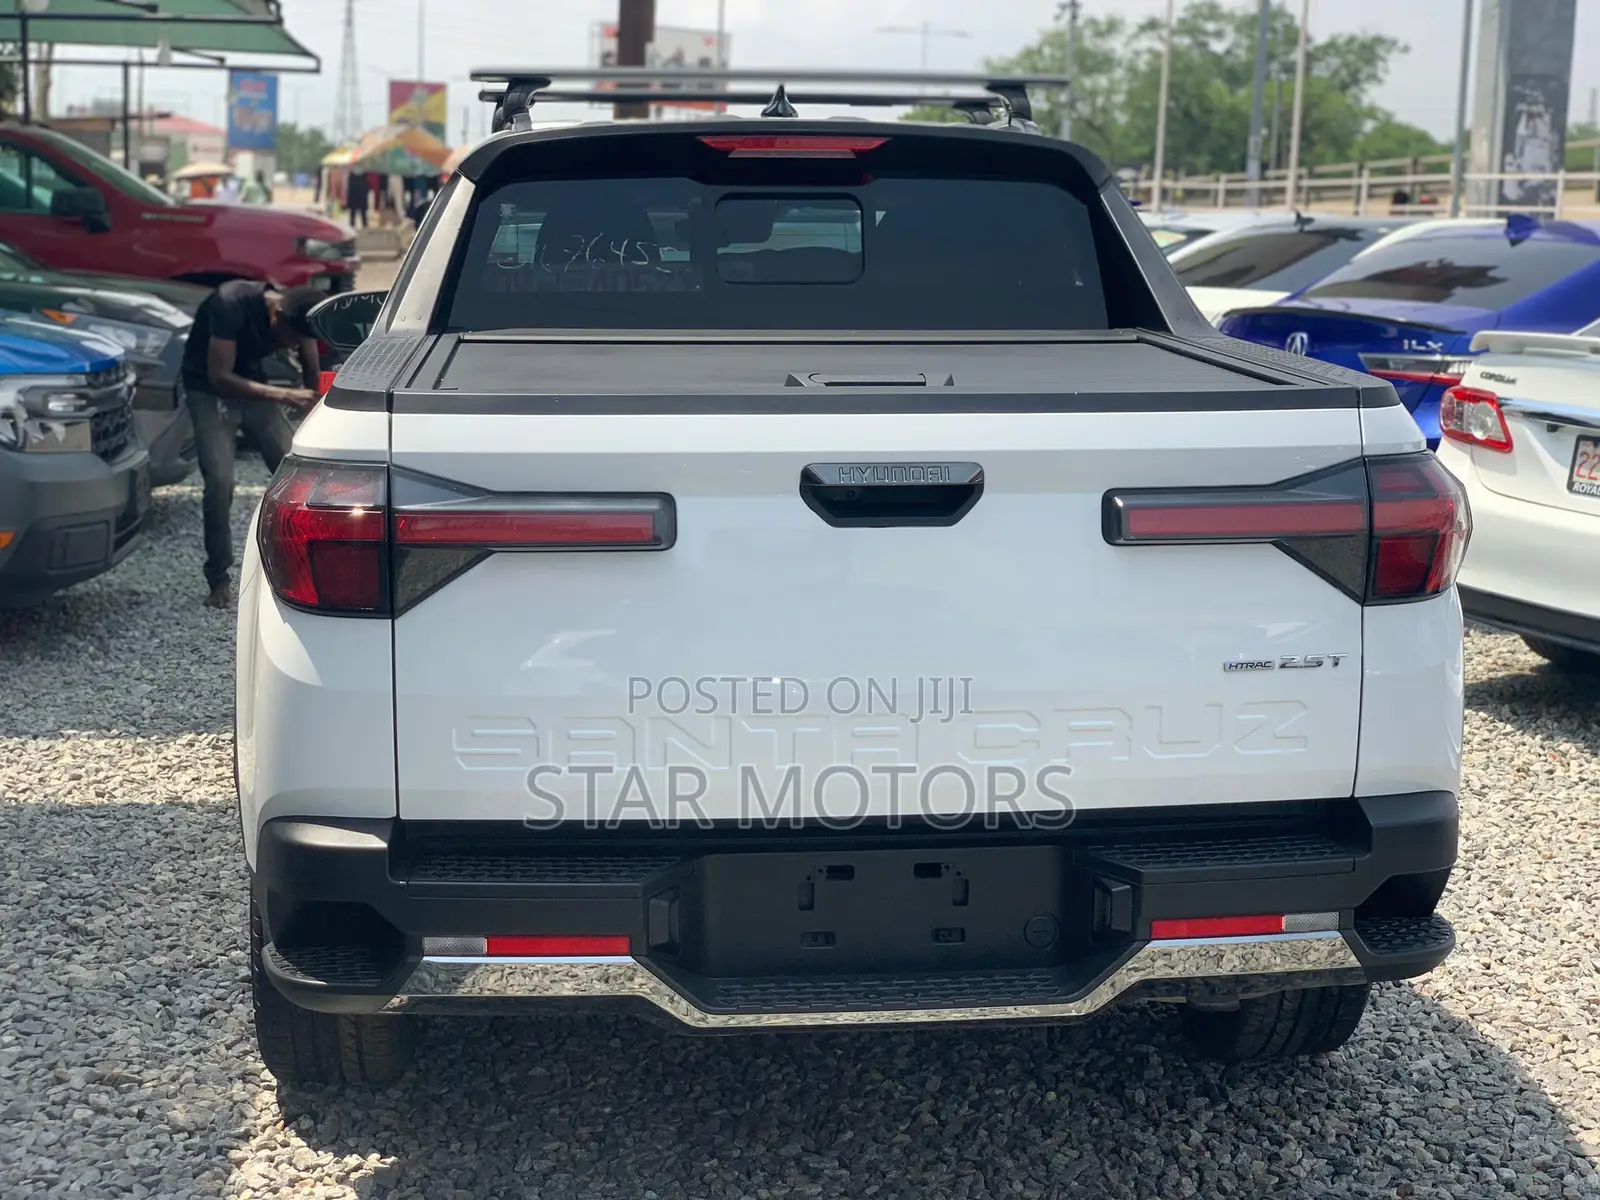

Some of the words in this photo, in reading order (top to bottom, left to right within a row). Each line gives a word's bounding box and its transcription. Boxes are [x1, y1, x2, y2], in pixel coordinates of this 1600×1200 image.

[1403, 339, 1443, 351] ILX
[838, 465, 950, 483] HYUNDAI
[1228, 660, 1273, 670] HTRAC
[452, 713, 919, 770] SANTA
[957, 700, 1308, 764] CRUZ
